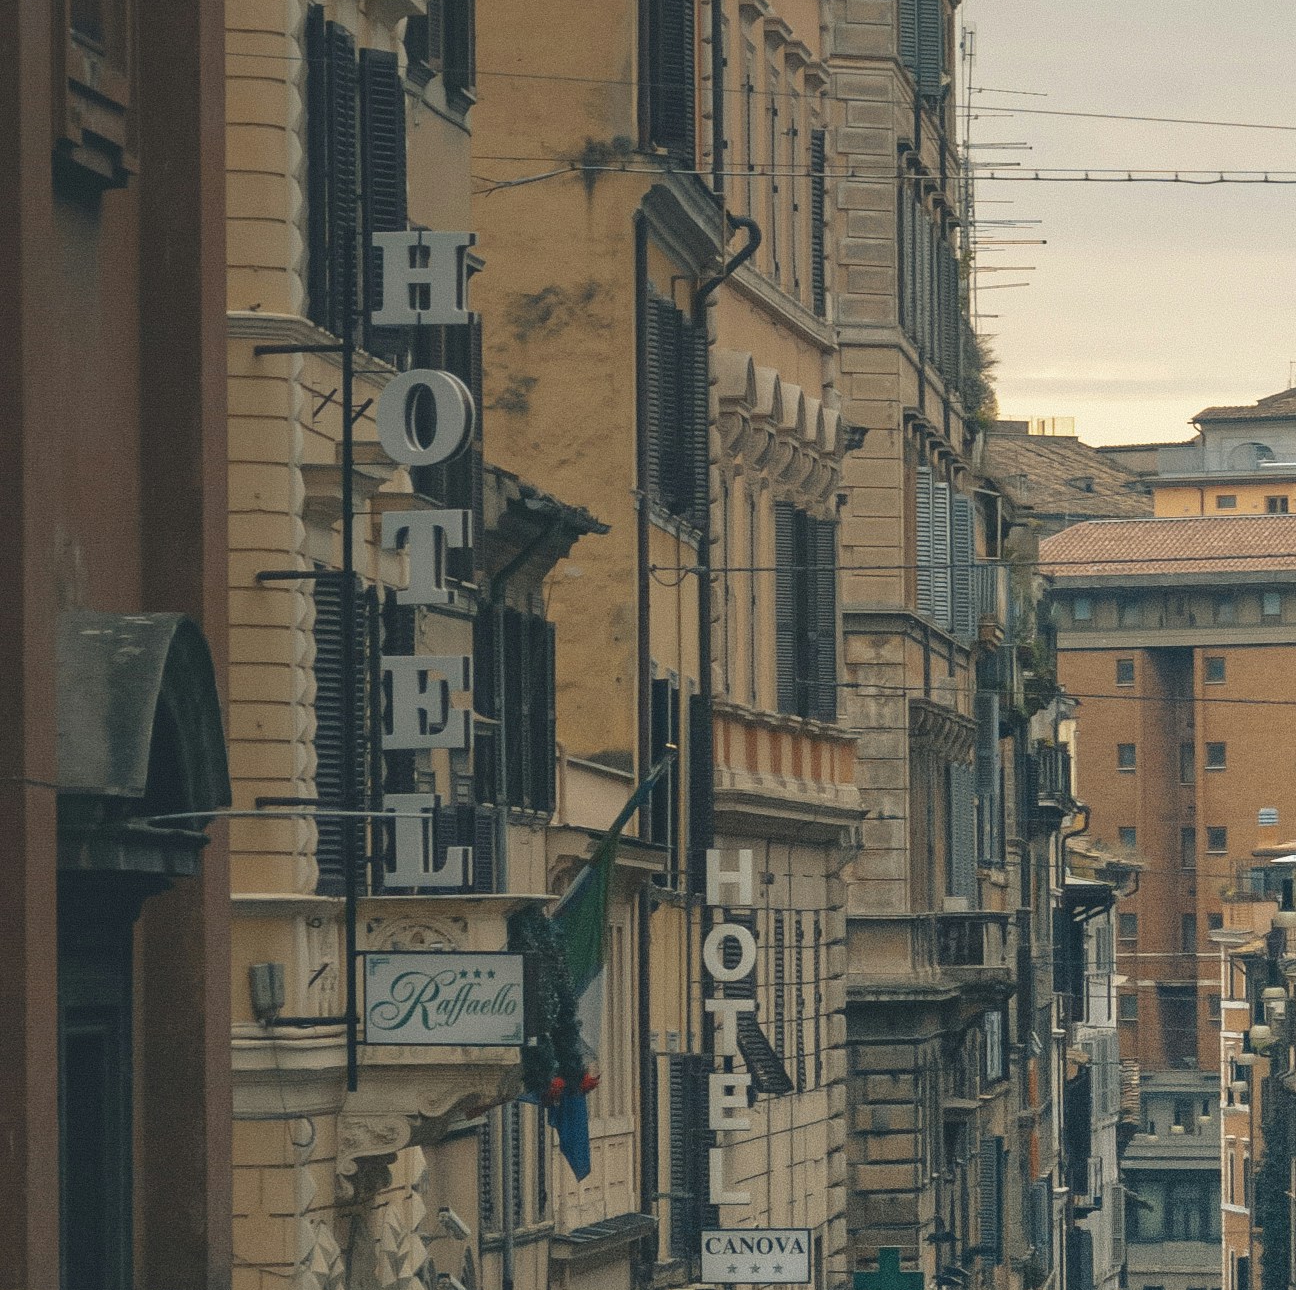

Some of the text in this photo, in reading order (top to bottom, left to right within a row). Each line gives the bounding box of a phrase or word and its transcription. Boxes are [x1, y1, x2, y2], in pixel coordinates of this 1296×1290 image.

[371, 230, 479, 887] HOTEL
[369, 969, 521, 1031] Raffaello
[703, 848, 757, 1205] HOTEL
[705, 1236, 806, 1255] CANOVA
